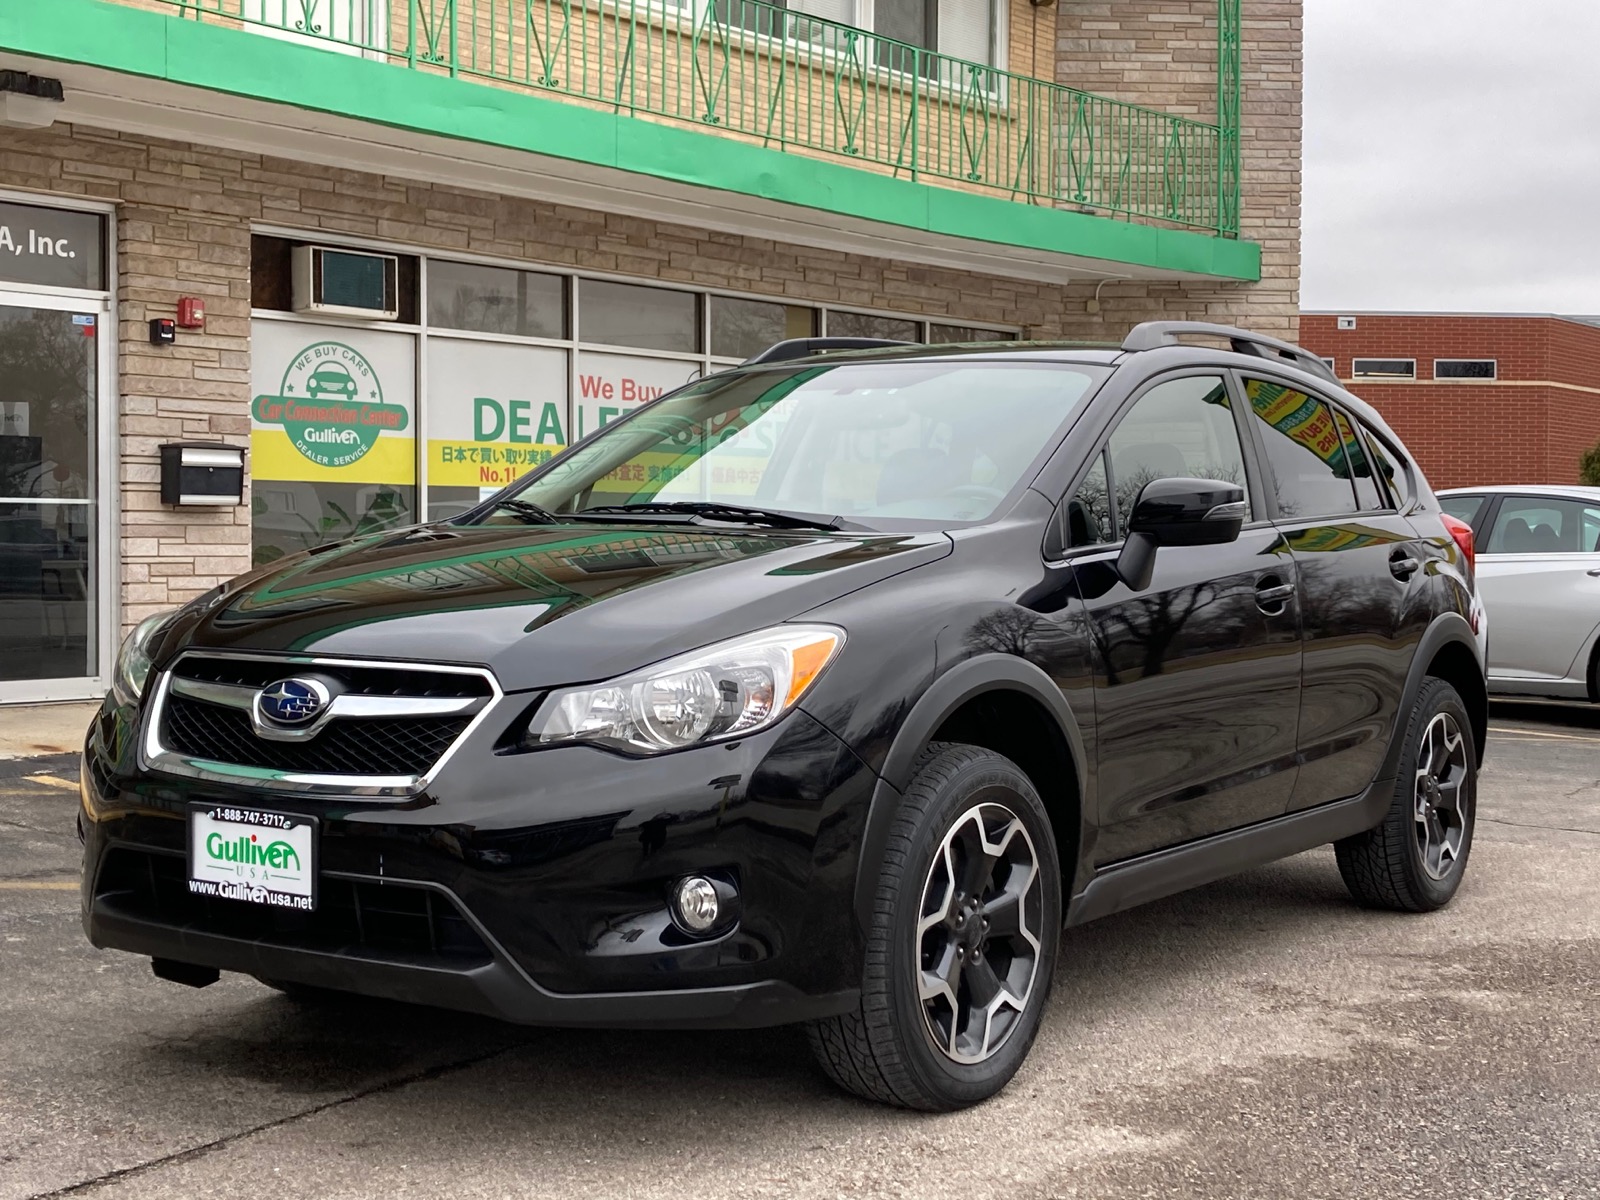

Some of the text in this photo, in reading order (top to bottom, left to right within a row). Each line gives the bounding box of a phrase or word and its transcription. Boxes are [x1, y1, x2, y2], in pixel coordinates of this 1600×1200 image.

[29, 229, 76, 258] Inc.
[295, 346, 369, 377] WE BUY CARS
[580, 375, 613, 400] We
[259, 398, 402, 428] Car Connection Center
[304, 427, 361, 445] Gulliver
[296, 440, 369, 466] DEALER SERVICE
[480, 466, 516, 483] No.1!
[216, 808, 285, 827] 1-888-747-3717
[206, 832, 300, 871] Gulliver
